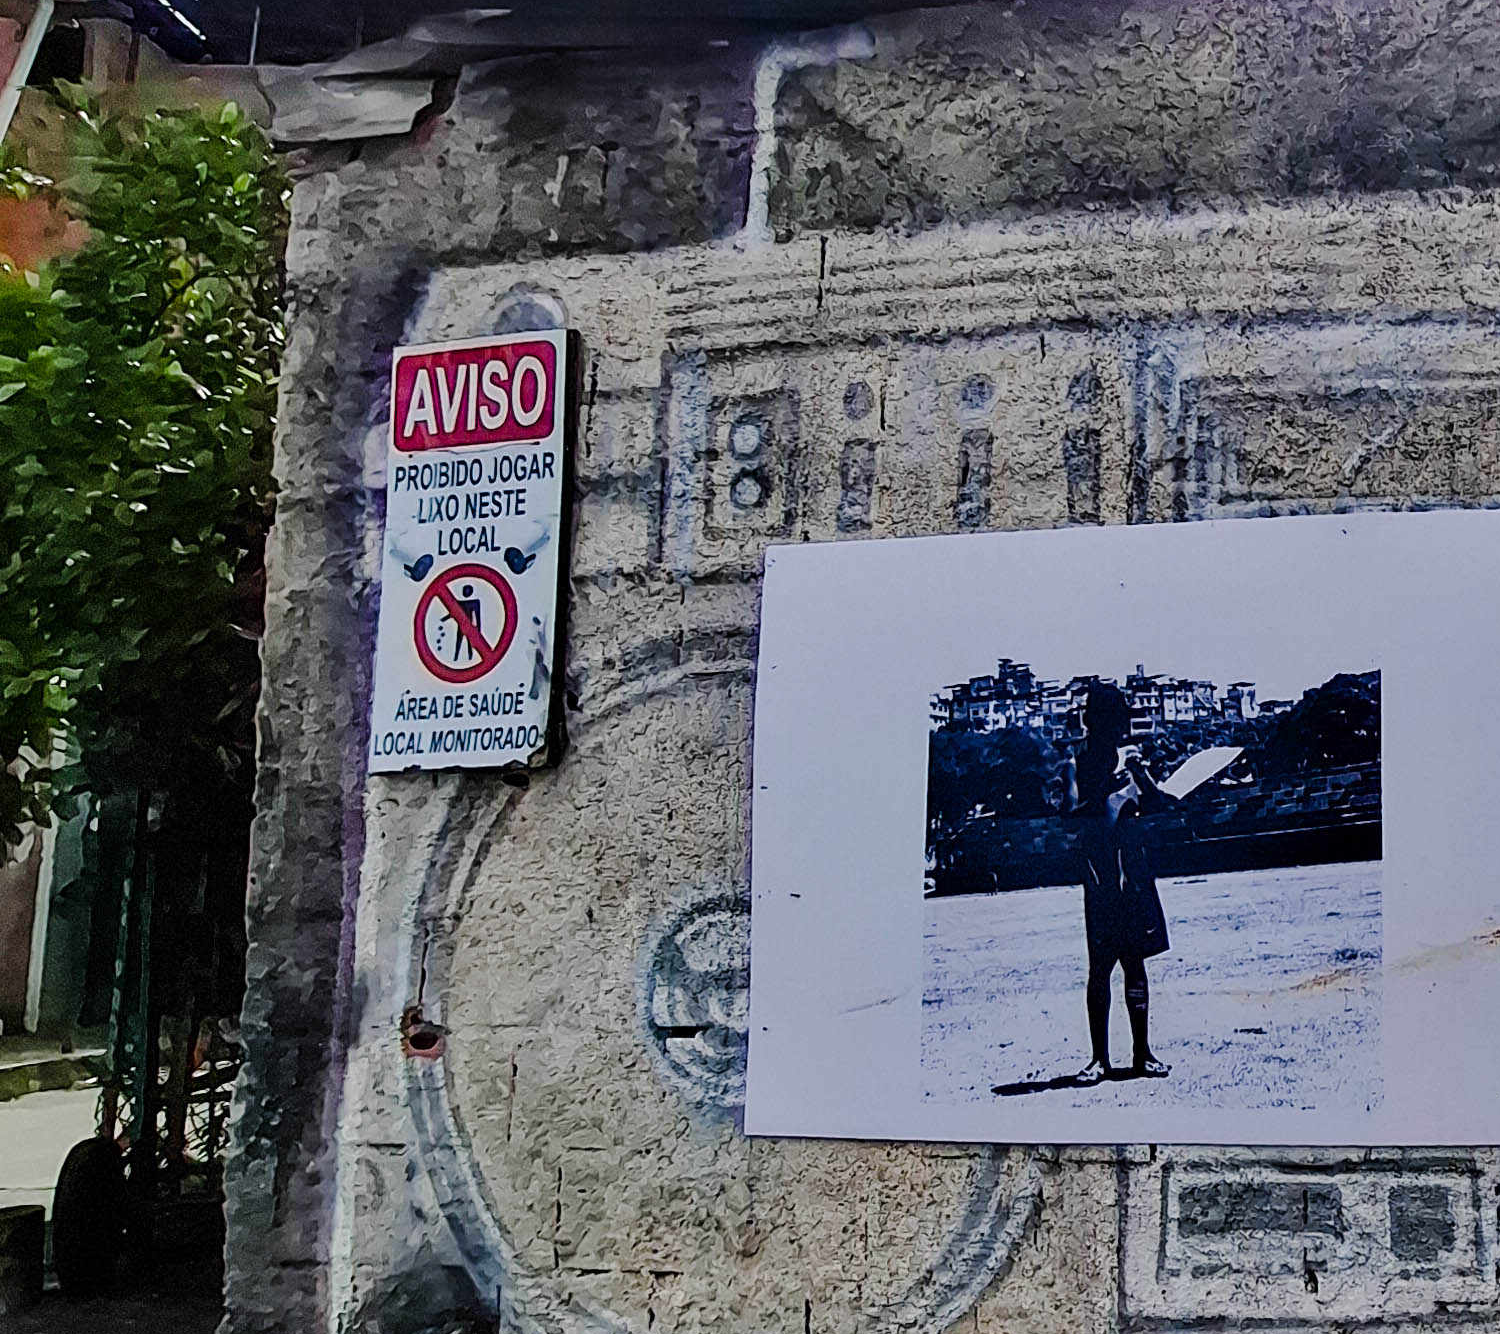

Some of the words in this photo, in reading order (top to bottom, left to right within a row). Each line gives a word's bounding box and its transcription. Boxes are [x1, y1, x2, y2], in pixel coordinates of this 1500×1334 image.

[403, 356, 546, 438] AVISO
[394, 458, 483, 492] PROIBIDO
[488, 452, 555, 482] JOGAR
[417, 494, 460, 524] LIXO
[464, 488, 526, 518] NESTE
[438, 526, 501, 556] LOCAL
[395, 691, 439, 722] ÁREA
[443, 696, 464, 718] DE
[469, 687, 524, 716] SAÚDE
[374, 729, 425, 757] LOCAL
[429, 724, 539, 753] MONITORADO
